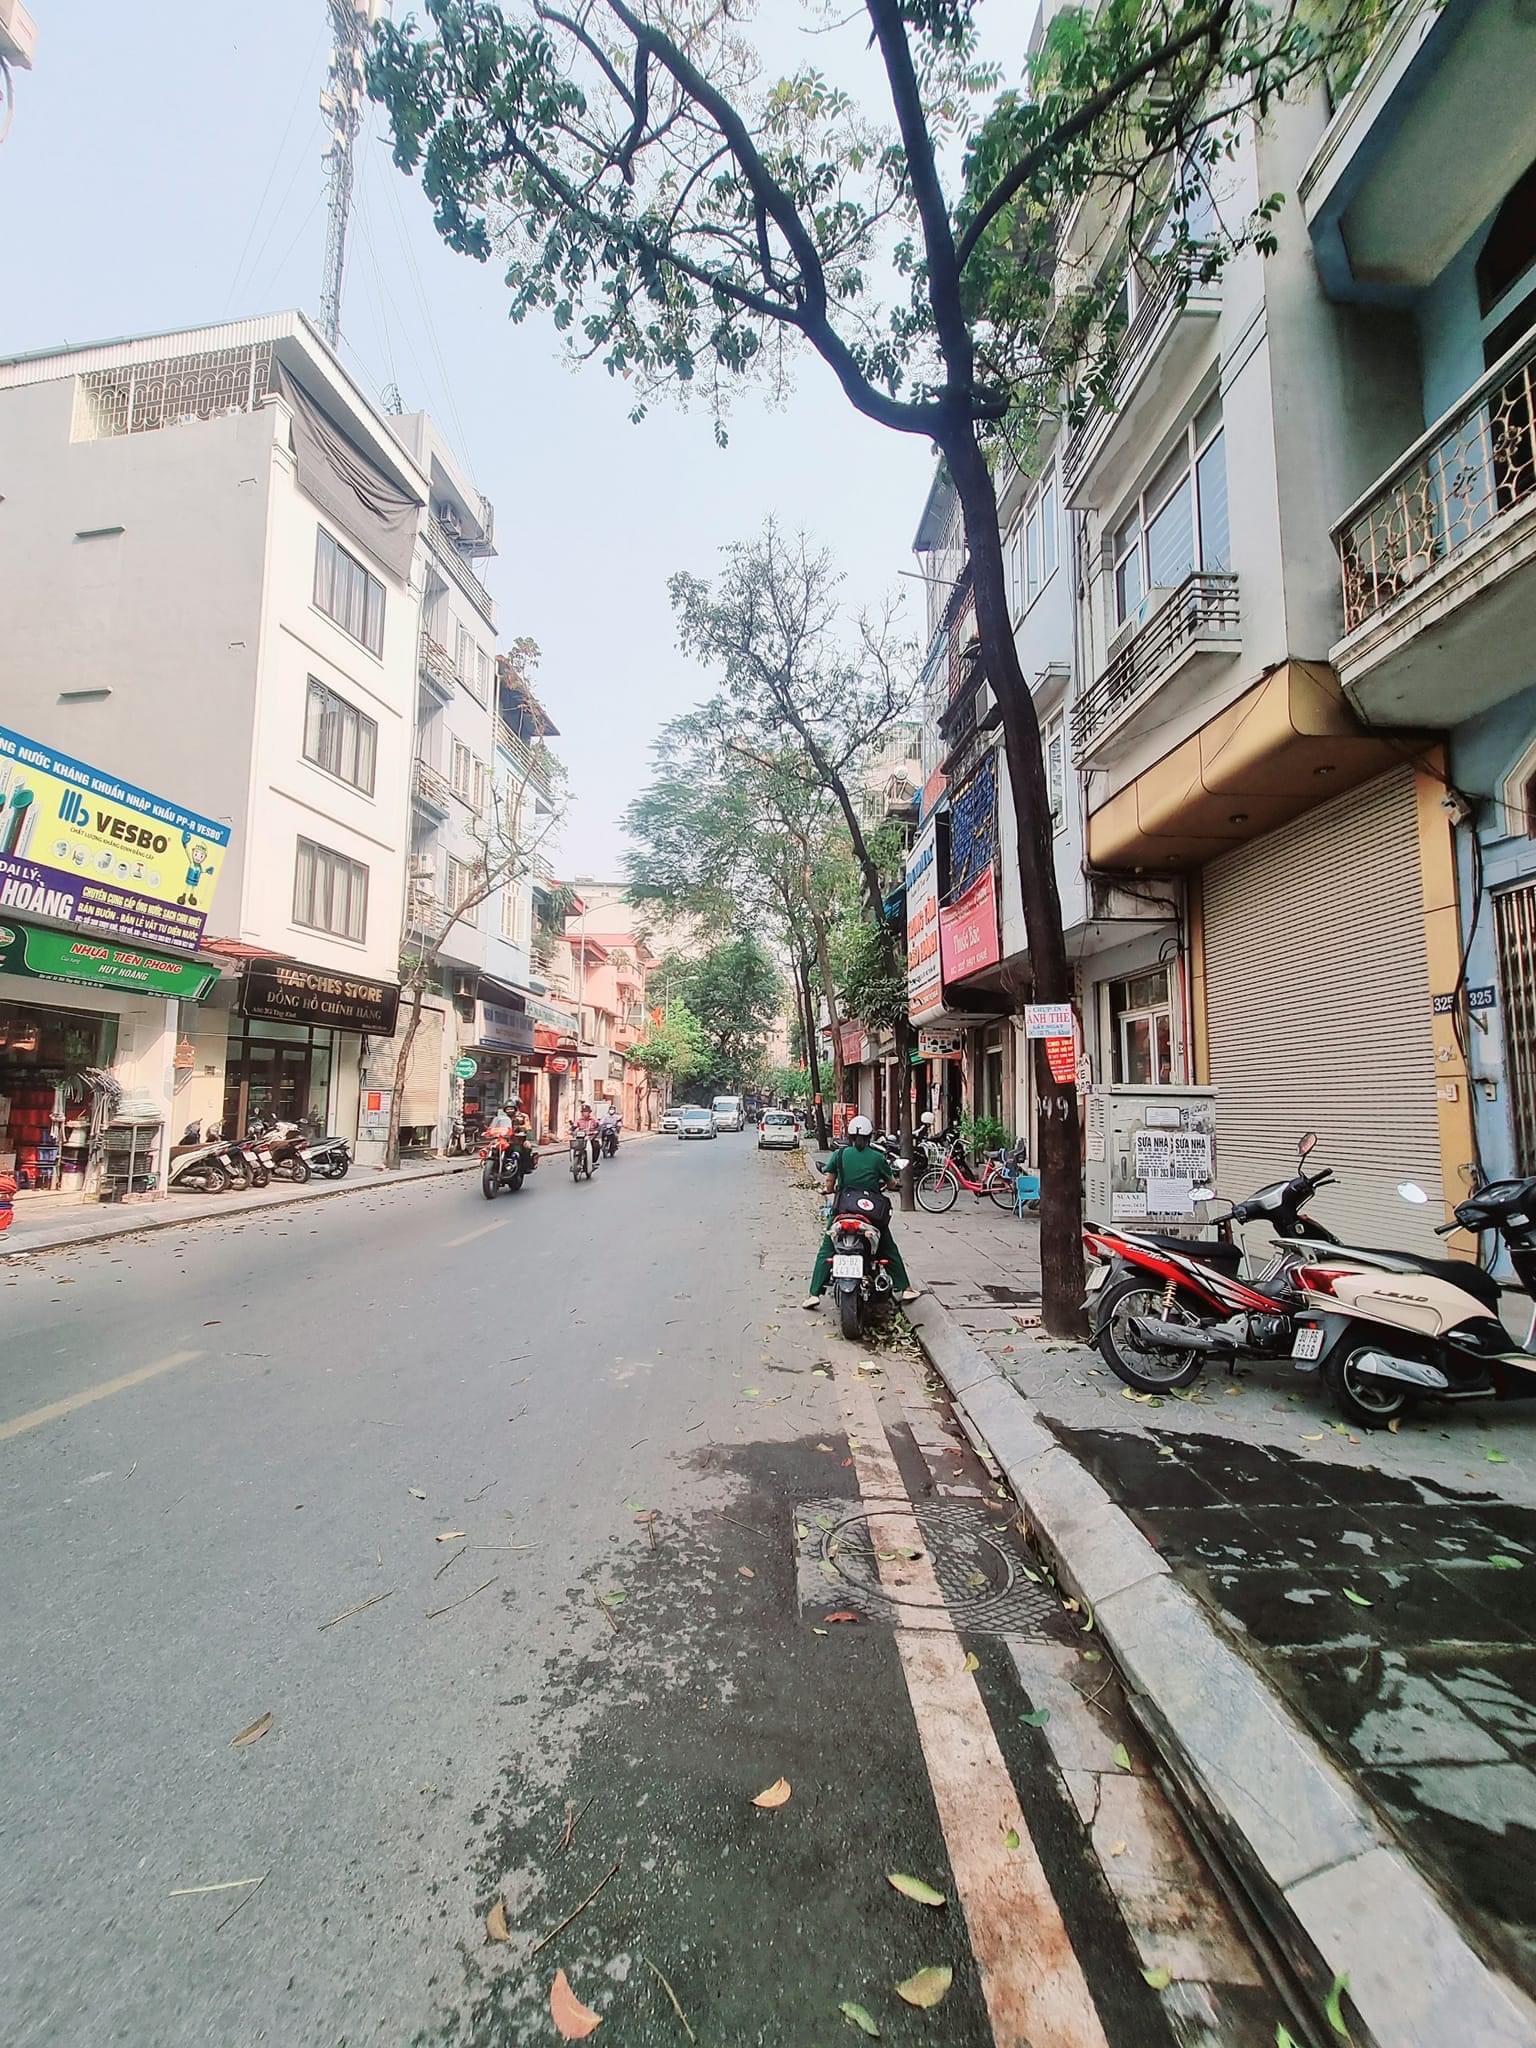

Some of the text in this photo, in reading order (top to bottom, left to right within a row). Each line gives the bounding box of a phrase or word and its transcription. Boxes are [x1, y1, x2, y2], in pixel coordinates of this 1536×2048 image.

[18, 745, 52, 770] NƯỚC
[52, 760, 91, 787] KHÁNG
[97, 811, 168, 854] VESBO
[0, 877, 74, 920] HOÀNG
[70, 942, 109, 960] NHỰA
[143, 958, 183, 974] PHONG
[98, 964, 119, 975] HUY
[276, 967, 384, 1003] WATCHES STORE
[1469, 989, 1493, 1007] 325
[266, 986, 300, 1007] ĐỒNG
[302, 992, 319, 1010] HỒ
[320, 1000, 354, 1017] CHÍNH
[1373, 1288, 1429, 1302] LEAD
